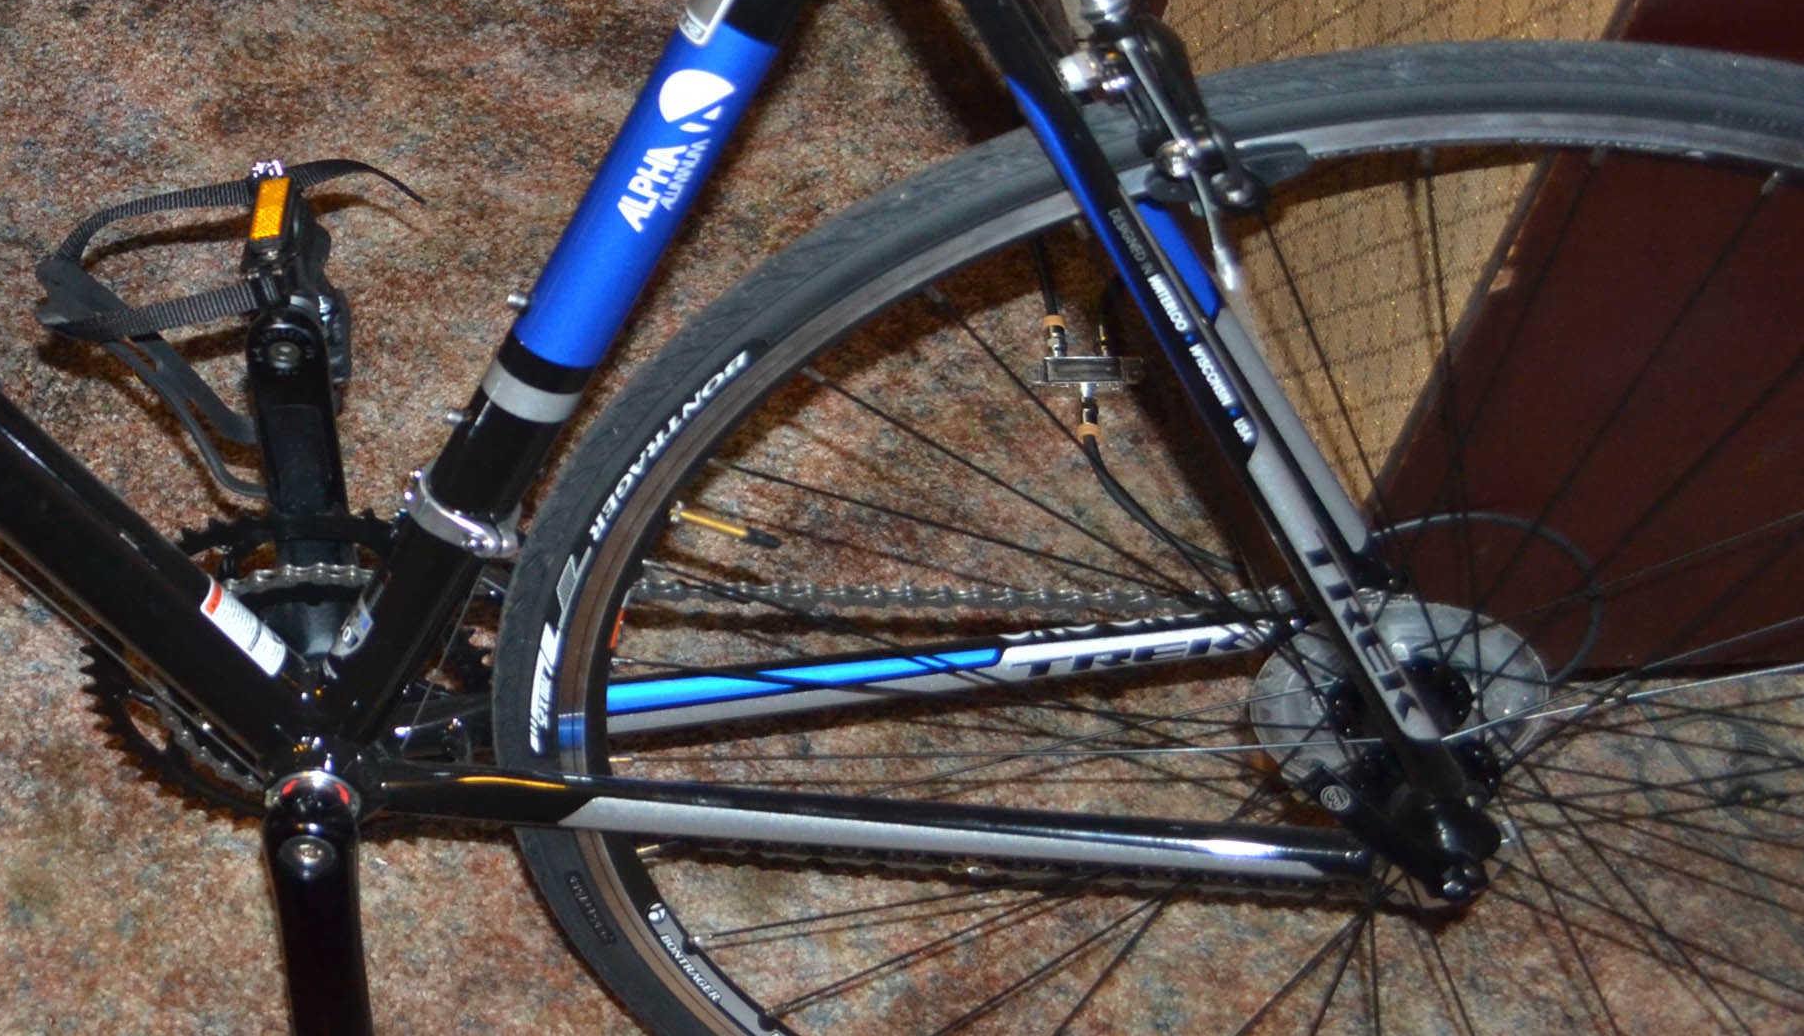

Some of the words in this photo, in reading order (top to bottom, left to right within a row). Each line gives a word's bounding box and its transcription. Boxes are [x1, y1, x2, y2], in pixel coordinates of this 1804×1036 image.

[617, 144, 688, 233] ALPHA
[1147, 272, 1188, 332] WATERLOO
[1188, 343, 1235, 407] WISCONSIN
[1233, 417, 1255, 443] USA
[588, 349, 754, 543] BONTRAGER
[1011, 626, 1252, 677] TREK
[1304, 545, 1422, 722] TREK
[660, 933, 723, 1003] BONTRAGER
